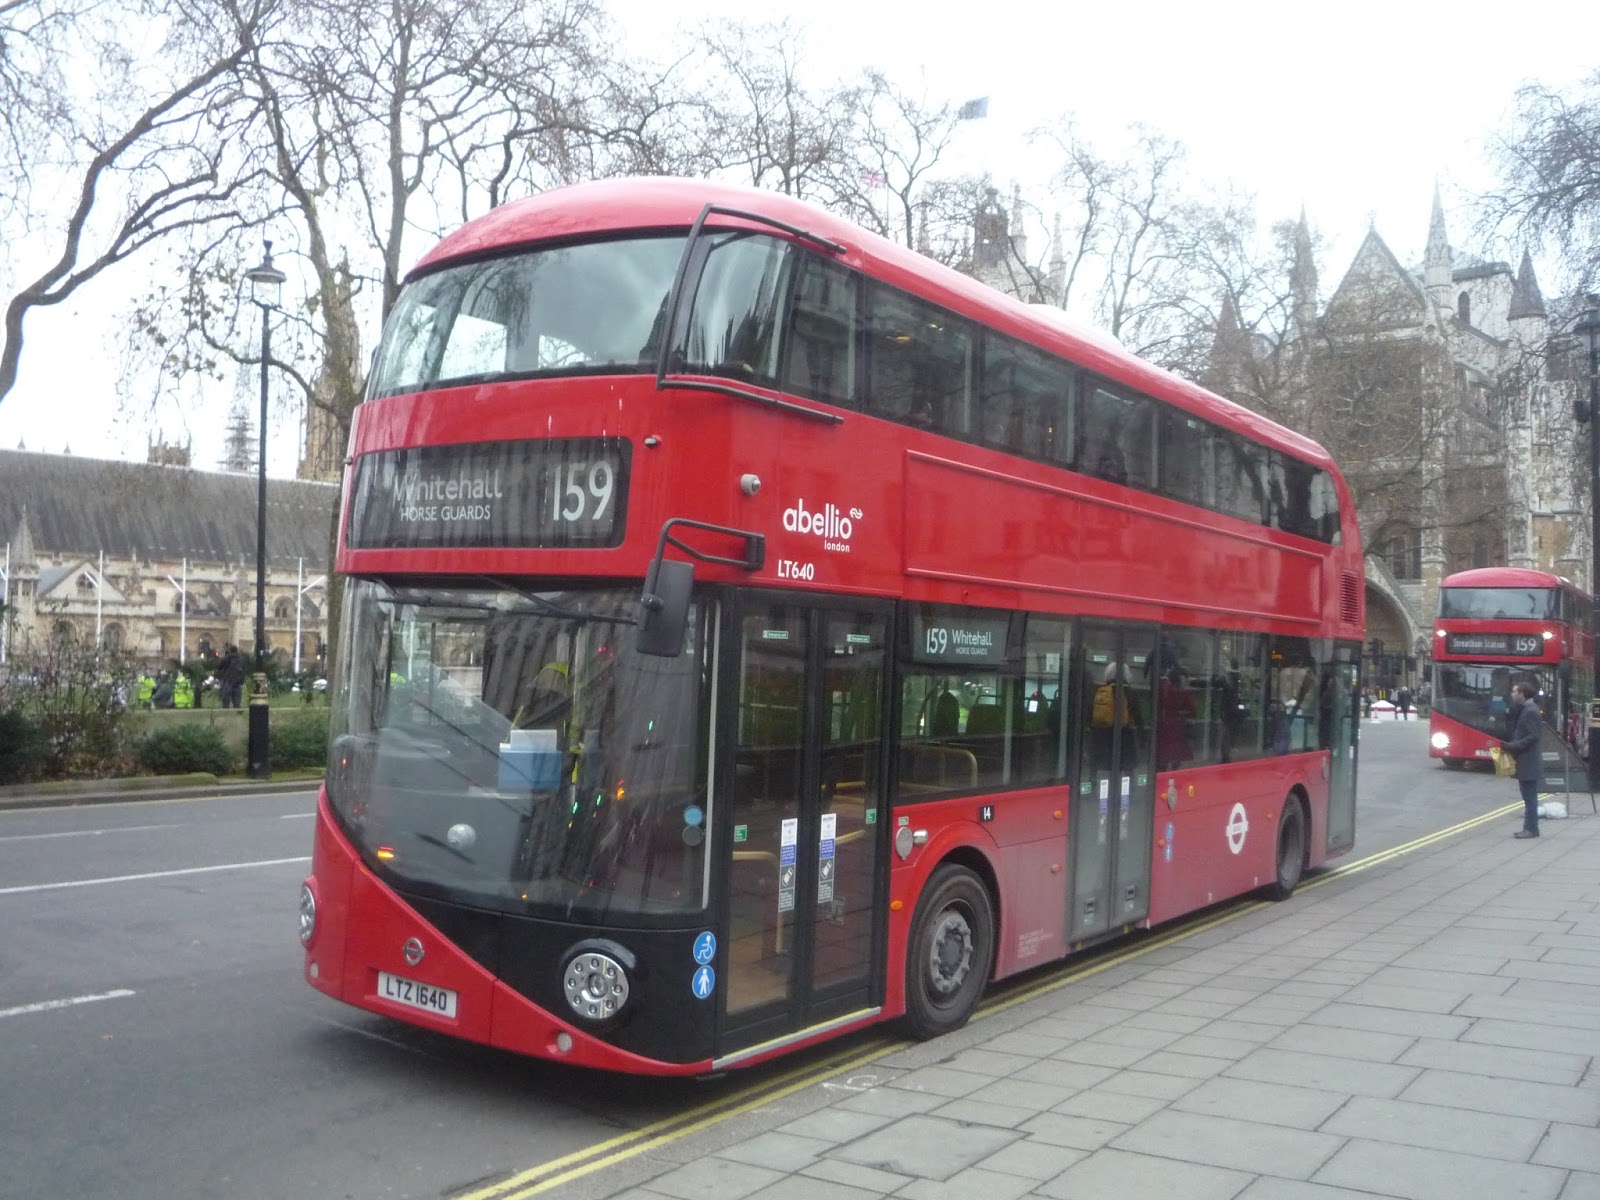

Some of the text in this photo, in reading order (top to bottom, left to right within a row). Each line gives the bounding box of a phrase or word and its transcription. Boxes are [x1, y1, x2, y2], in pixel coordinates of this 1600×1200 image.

[394, 468, 502, 500] Whitehall
[553, 460, 613, 521] 159
[401, 505, 491, 521] HORSE GUARDS
[783, 498, 852, 539] abellio
[824, 540, 850, 552] london
[778, 559, 815, 580] LT640
[926, 628, 948, 654] 159
[952, 629, 992, 646] Whitehall
[1516, 638, 1537, 651] 159
